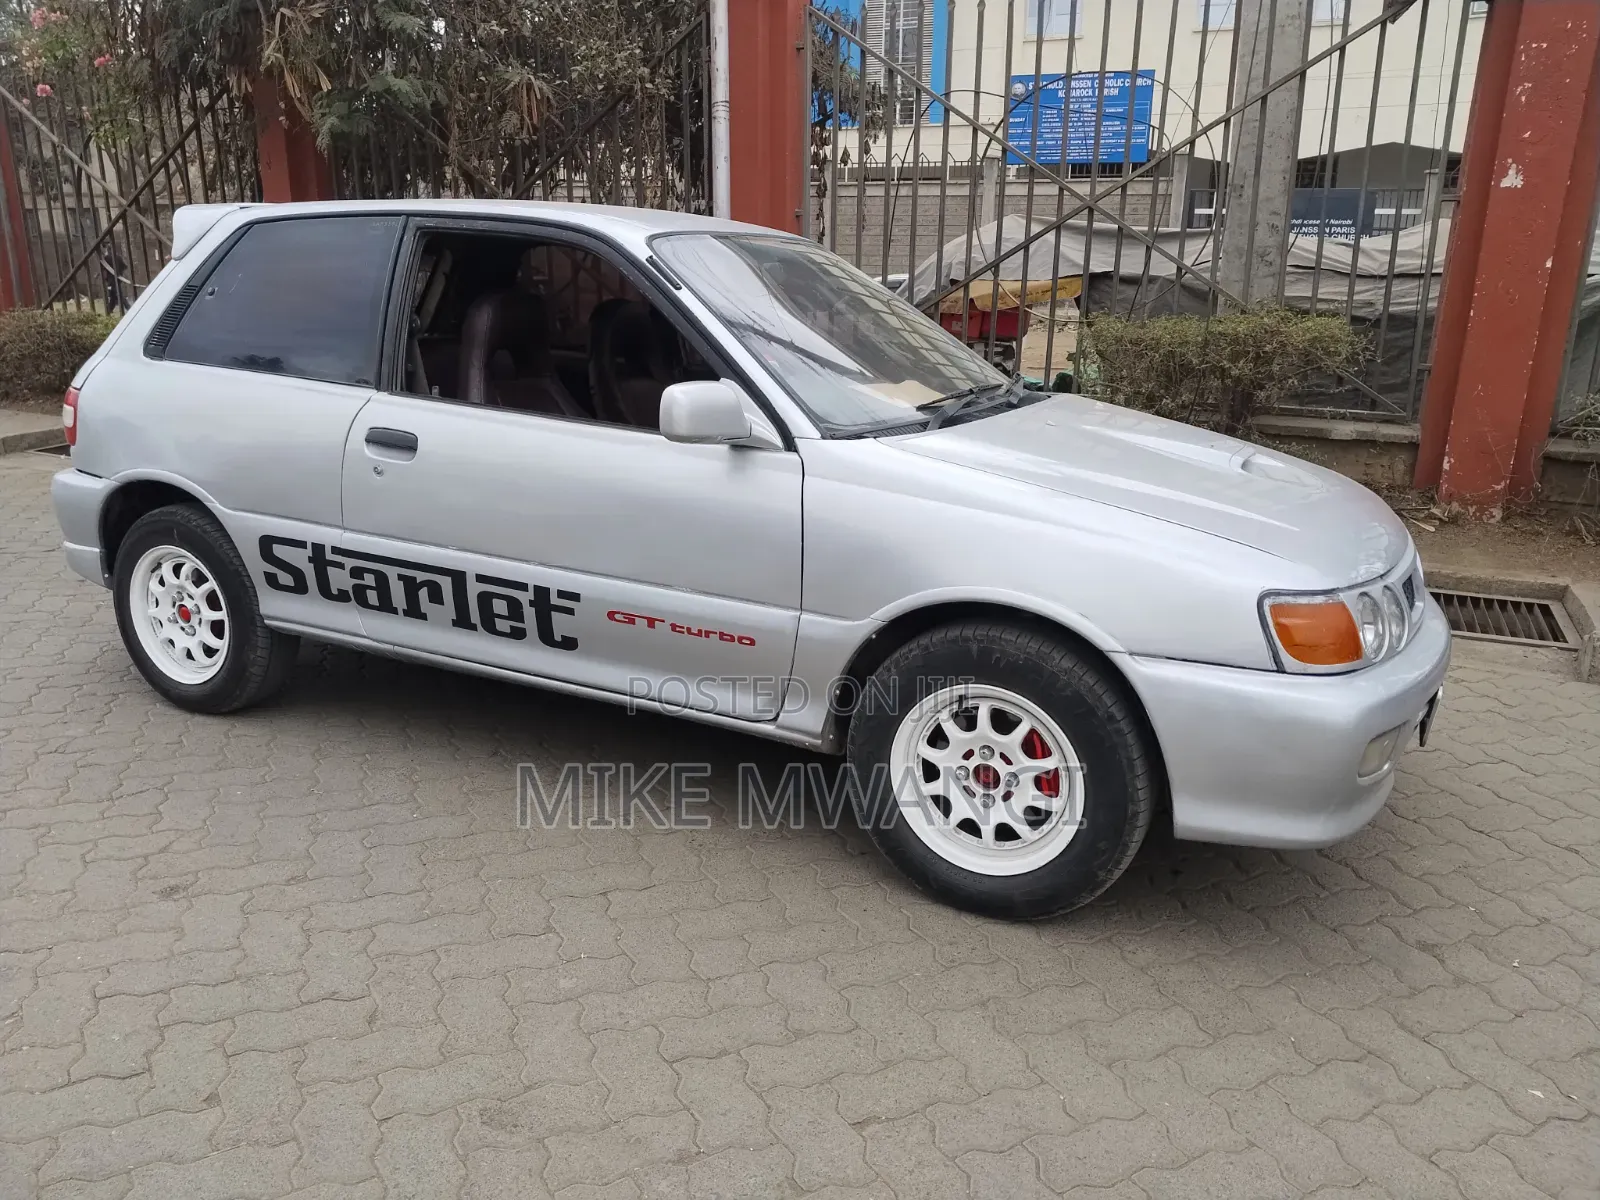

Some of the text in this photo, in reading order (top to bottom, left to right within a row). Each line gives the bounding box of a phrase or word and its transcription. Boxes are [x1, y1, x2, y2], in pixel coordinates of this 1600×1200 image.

[1063, 79, 1092, 89] NSSEN
[1094, 78, 1124, 88] CHOLIC
[1125, 77, 1152, 87] CRCH
[1058, 87, 1119, 98] KOAROCK RISH
[1291, 226, 1330, 234] JANSSN
[258, 534, 581, 652] Starlet
[606, 609, 757, 648] GT turbo
